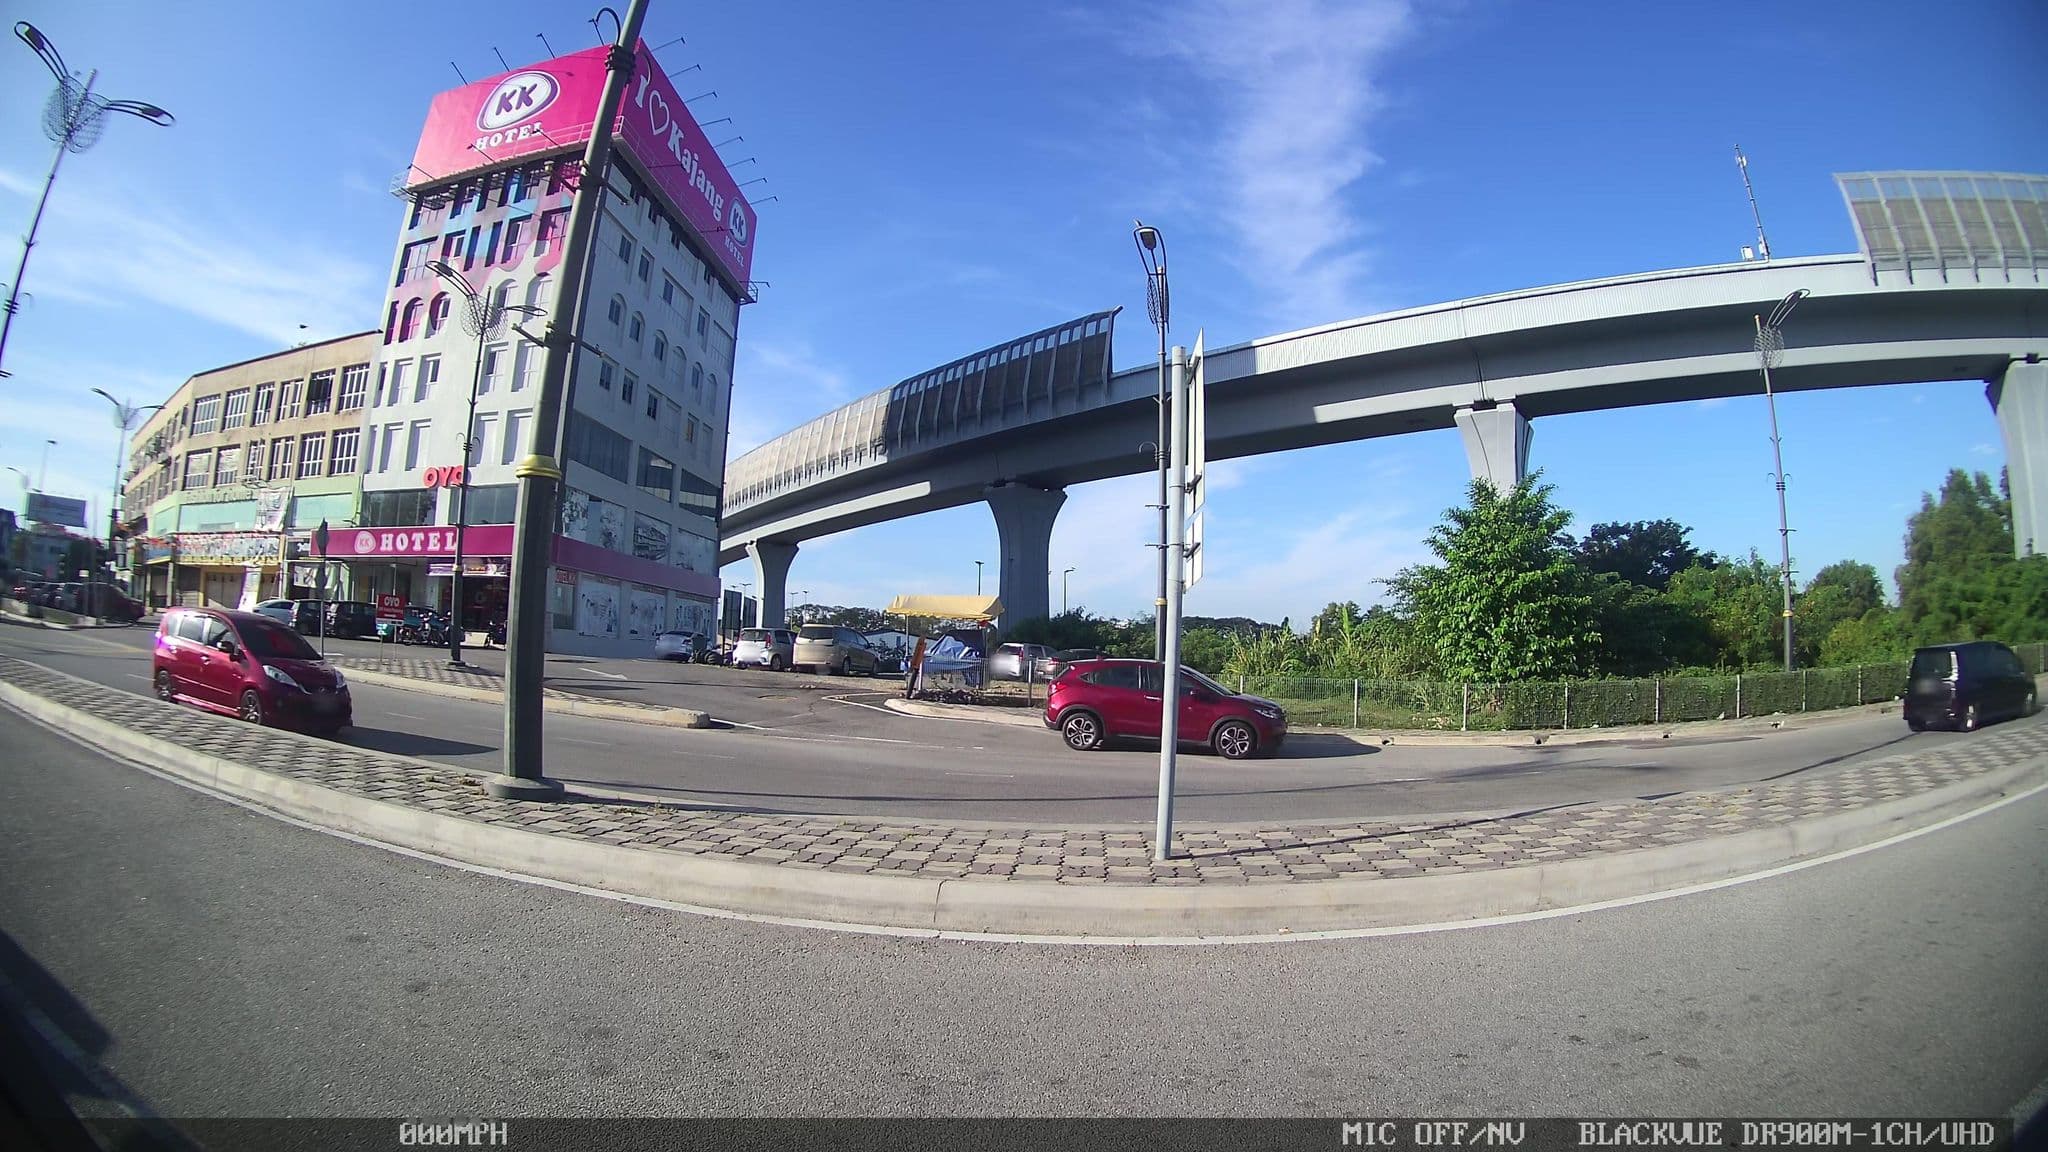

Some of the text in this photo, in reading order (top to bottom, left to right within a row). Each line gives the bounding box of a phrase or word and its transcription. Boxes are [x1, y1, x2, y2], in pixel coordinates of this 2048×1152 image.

[495, 83, 538, 116] KK
[475, 122, 543, 151] HOTEL
[635, 74, 725, 222] I Kajang
[732, 207, 744, 237] KK
[724, 235, 745, 267] HOTEL
[423, 464, 464, 488] OYO
[379, 531, 457, 551] HOTEL
[384, 596, 400, 607] OYO
